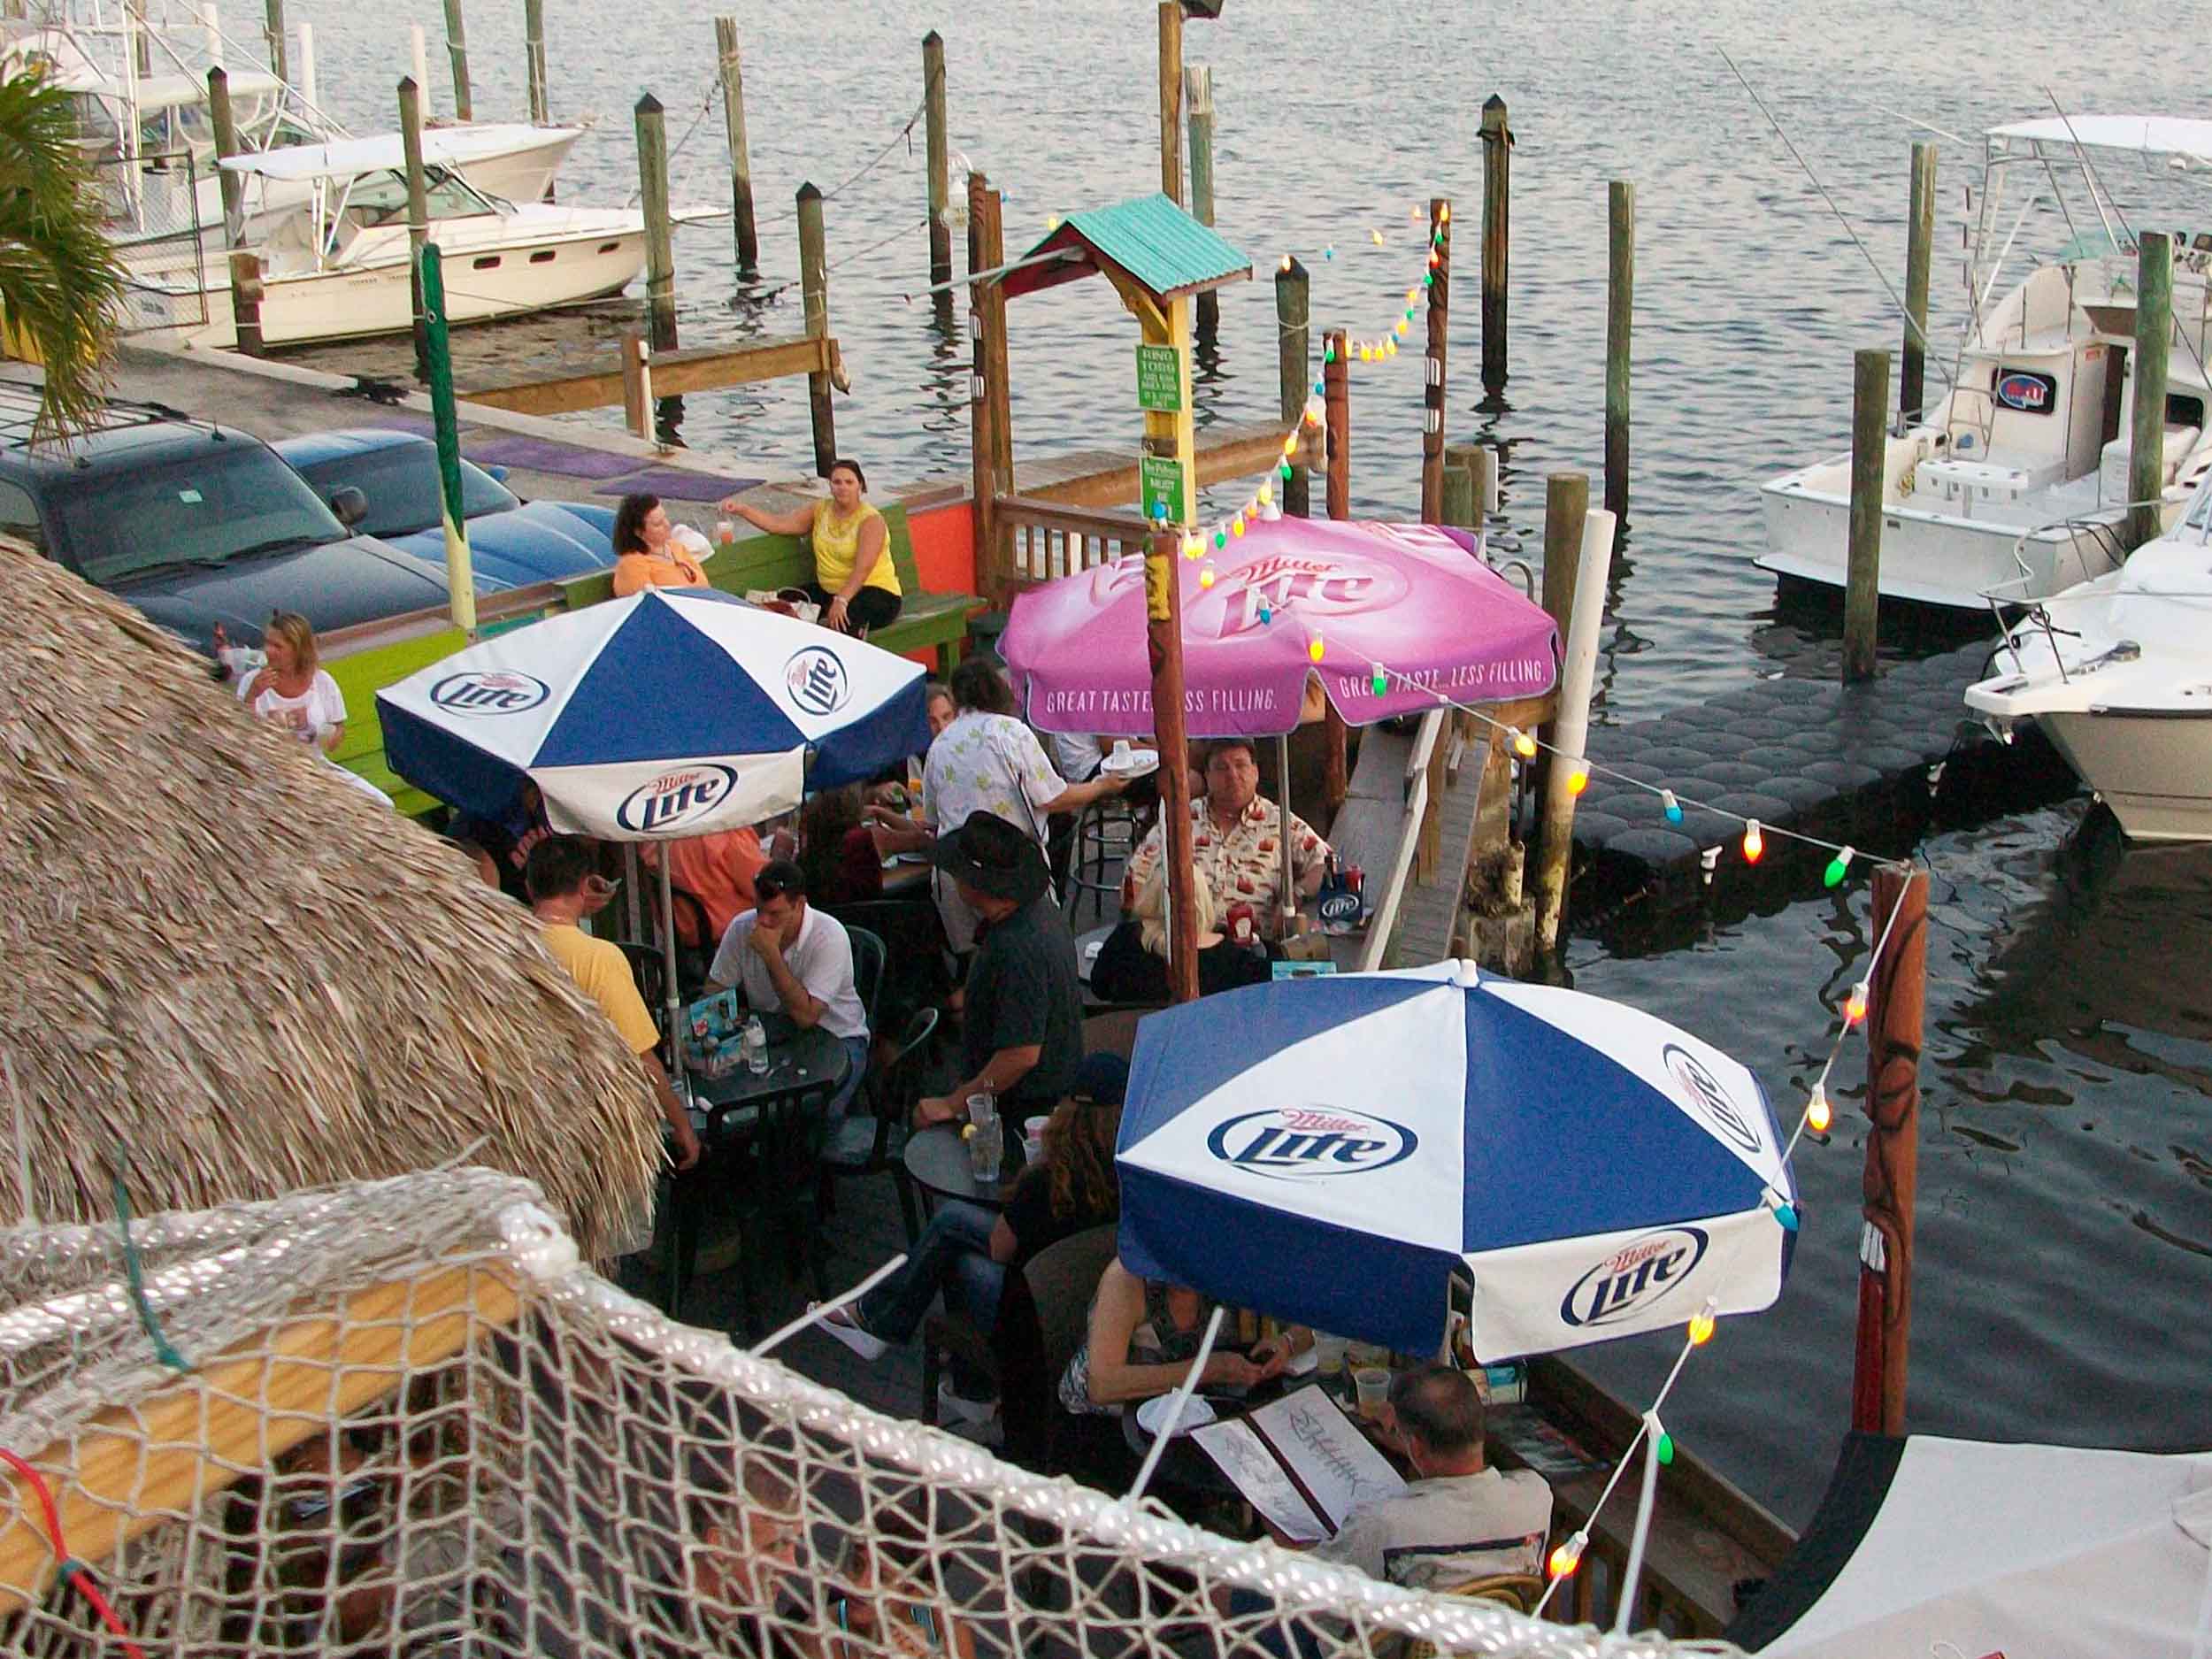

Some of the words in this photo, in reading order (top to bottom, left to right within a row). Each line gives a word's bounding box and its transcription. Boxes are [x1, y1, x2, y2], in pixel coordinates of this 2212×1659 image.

[1230, 557, 1341, 582] Miller
[1217, 573, 1373, 639] Lite
[442, 681, 532, 710] Lite
[803, 657, 837, 711] Lite
[1339, 673, 1392, 699] GRE
[1451, 664, 1486, 687] LESS
[1489, 659, 1548, 684] FILLING.
[1047, 689, 1098, 713] GREAT
[1212, 687, 1279, 712] FILLING.
[642, 778, 720, 832] Lite
[1280, 1107, 1371, 1133] Miller
[1684, 1061, 1758, 1145] Lite
[1231, 1126, 1388, 1166] Lite
[1602, 1240, 1671, 1273] Miller
[1586, 1246, 1687, 1323] Lite
